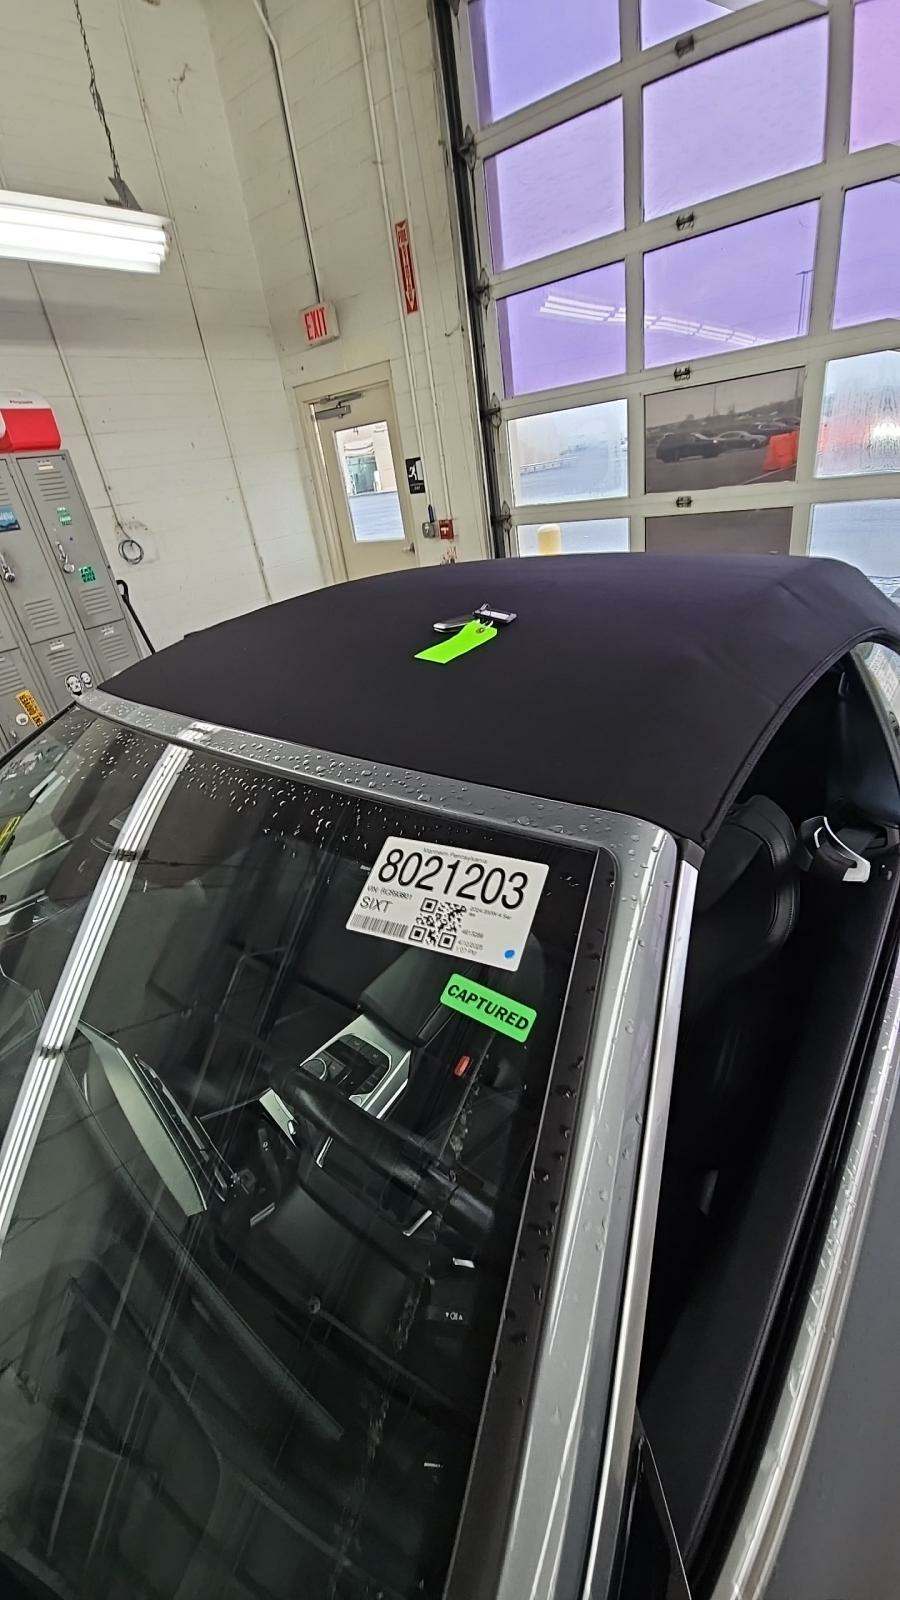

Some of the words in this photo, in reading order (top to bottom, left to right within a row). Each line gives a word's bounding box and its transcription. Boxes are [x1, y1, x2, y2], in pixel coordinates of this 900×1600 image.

[304, 307, 327, 341] EXIT
[378, 848, 528, 910] 8021203
[360, 895, 394, 914] SIXT
[447, 984, 529, 1031] CAPTURED
